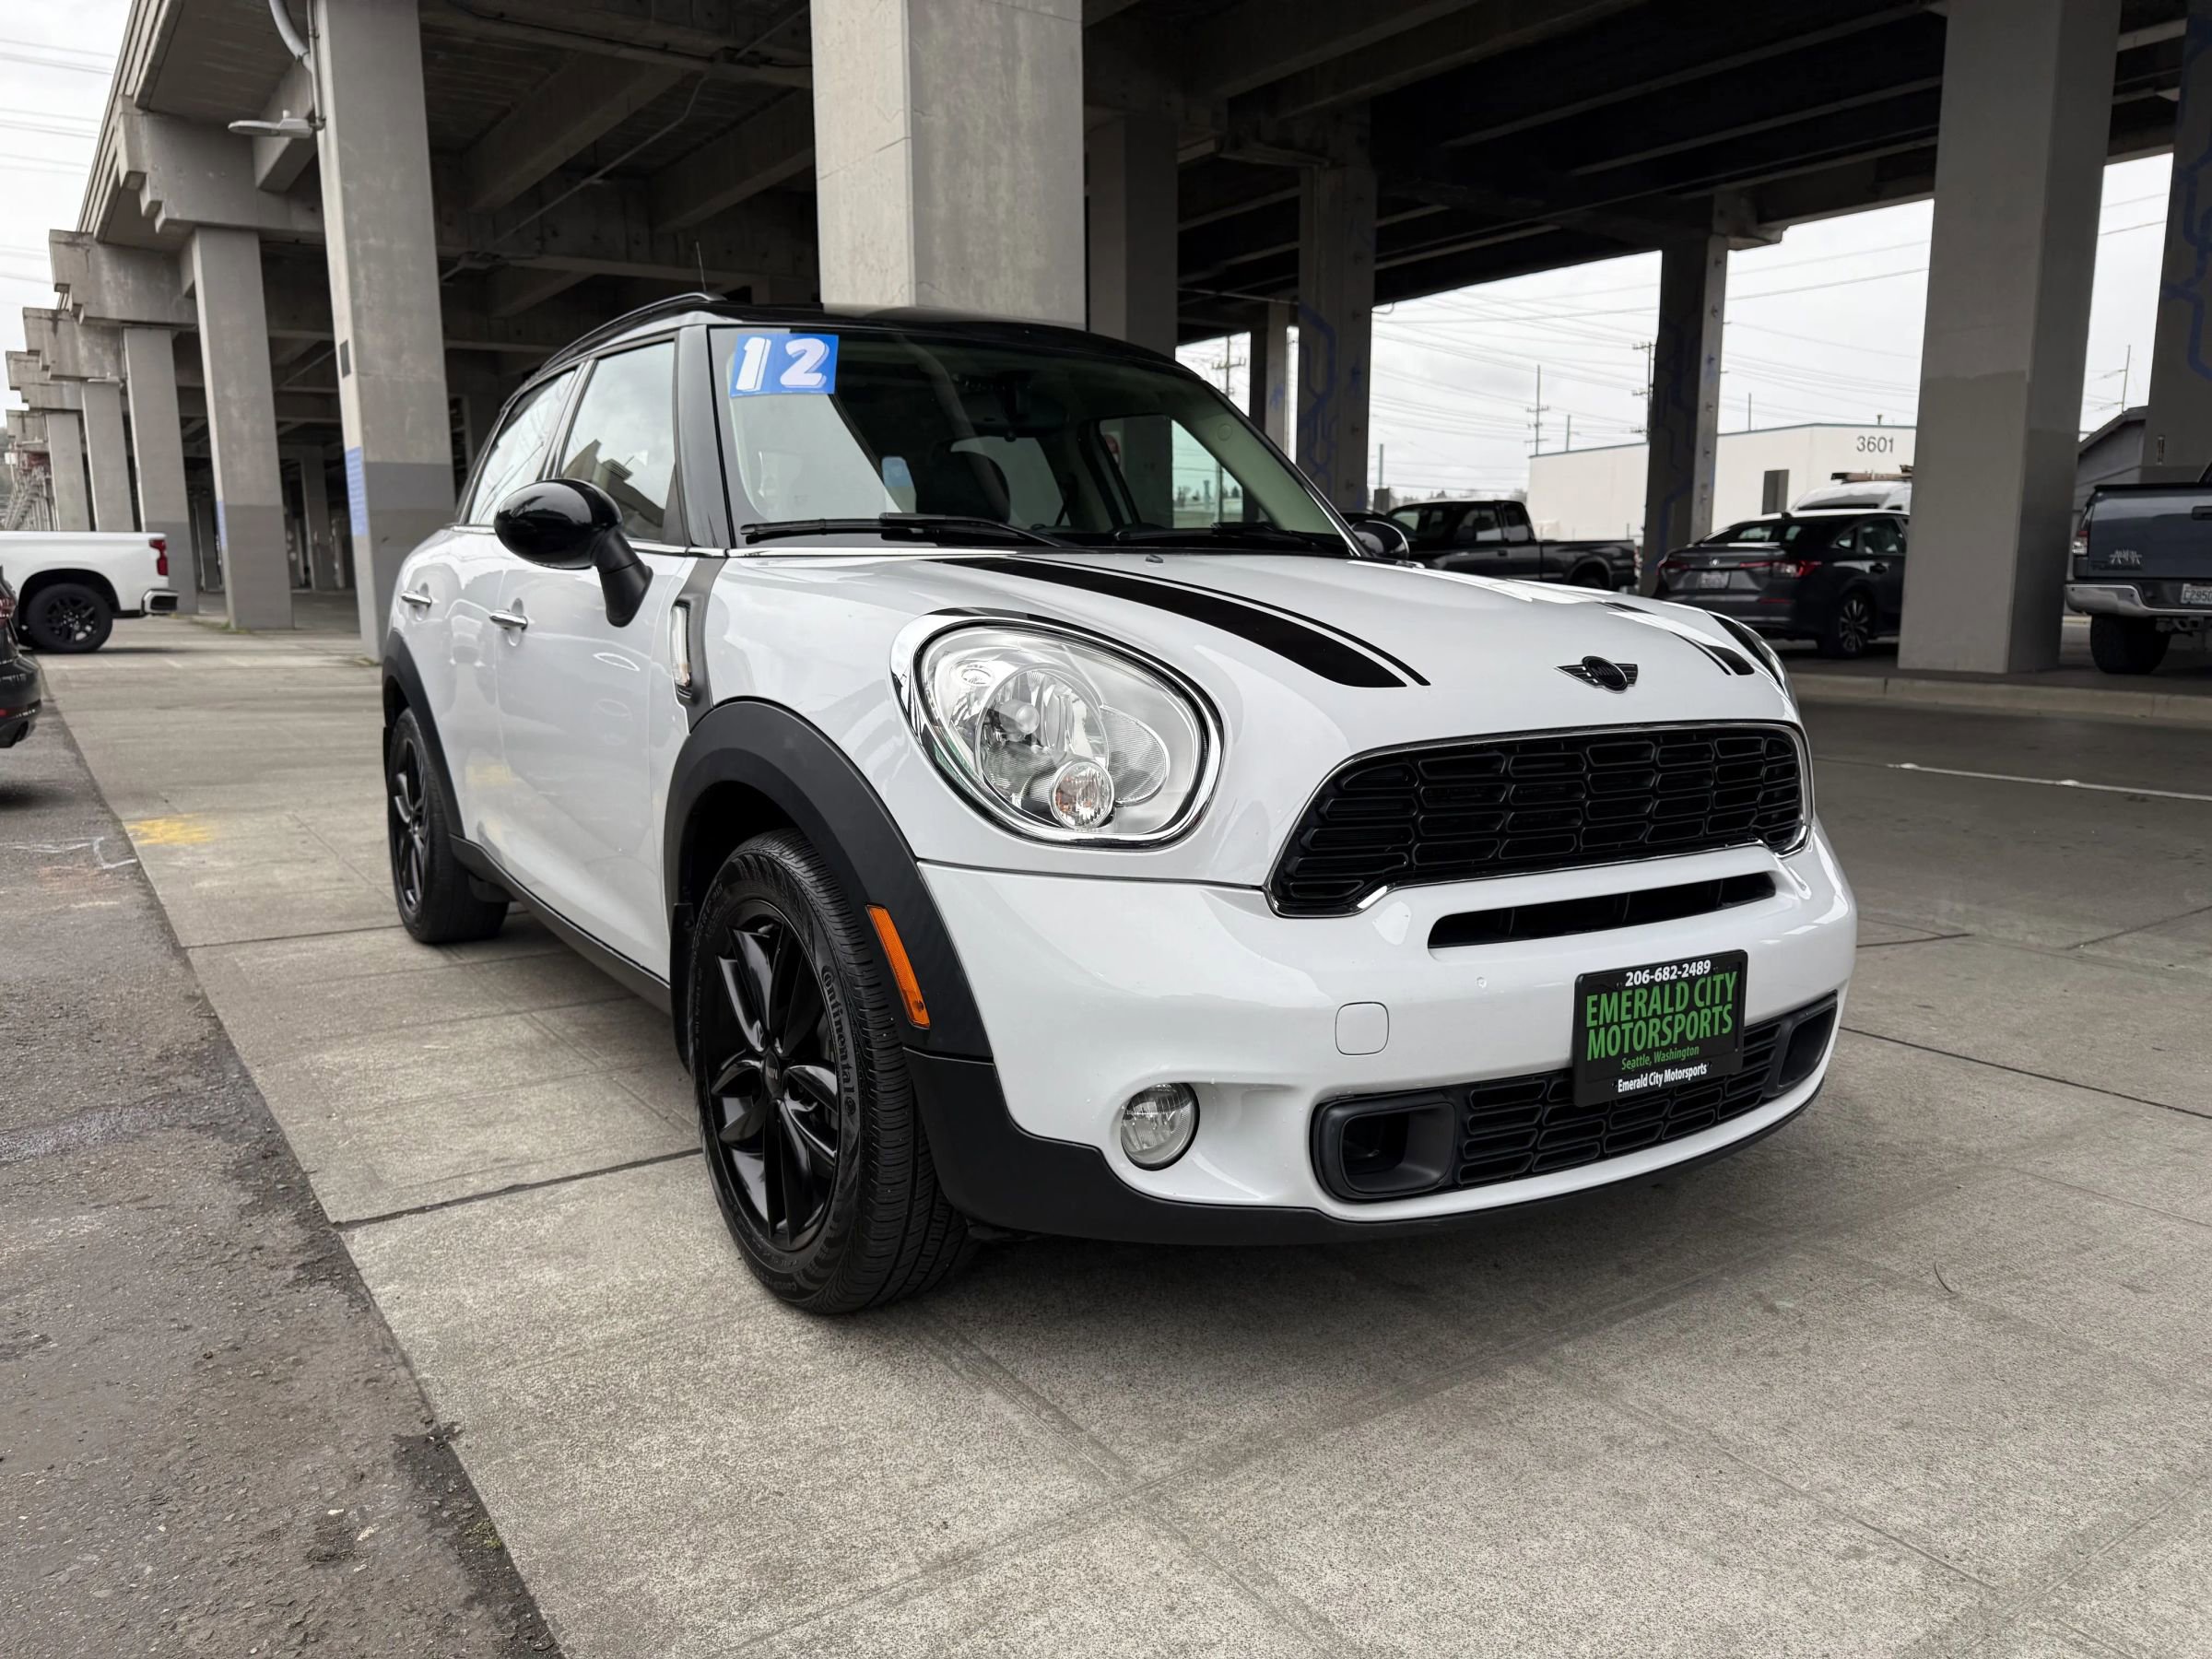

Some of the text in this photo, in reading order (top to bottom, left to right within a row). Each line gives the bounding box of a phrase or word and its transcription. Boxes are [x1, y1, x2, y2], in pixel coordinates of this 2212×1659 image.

[735, 336, 830, 392] 12
[1856, 435, 1894, 453] 3601
[1625, 959, 1711, 987] 206-682-2489
[1586, 971, 1737, 1028] EMERALD CITY
[821, 965, 855, 1094] Continental
[1587, 1004, 1733, 1061] MOTORSPORTS
[1618, 1063, 1707, 1093] Emerald City Motorsports
[1621, 1045, 1700, 1070] Seattle, Washington
